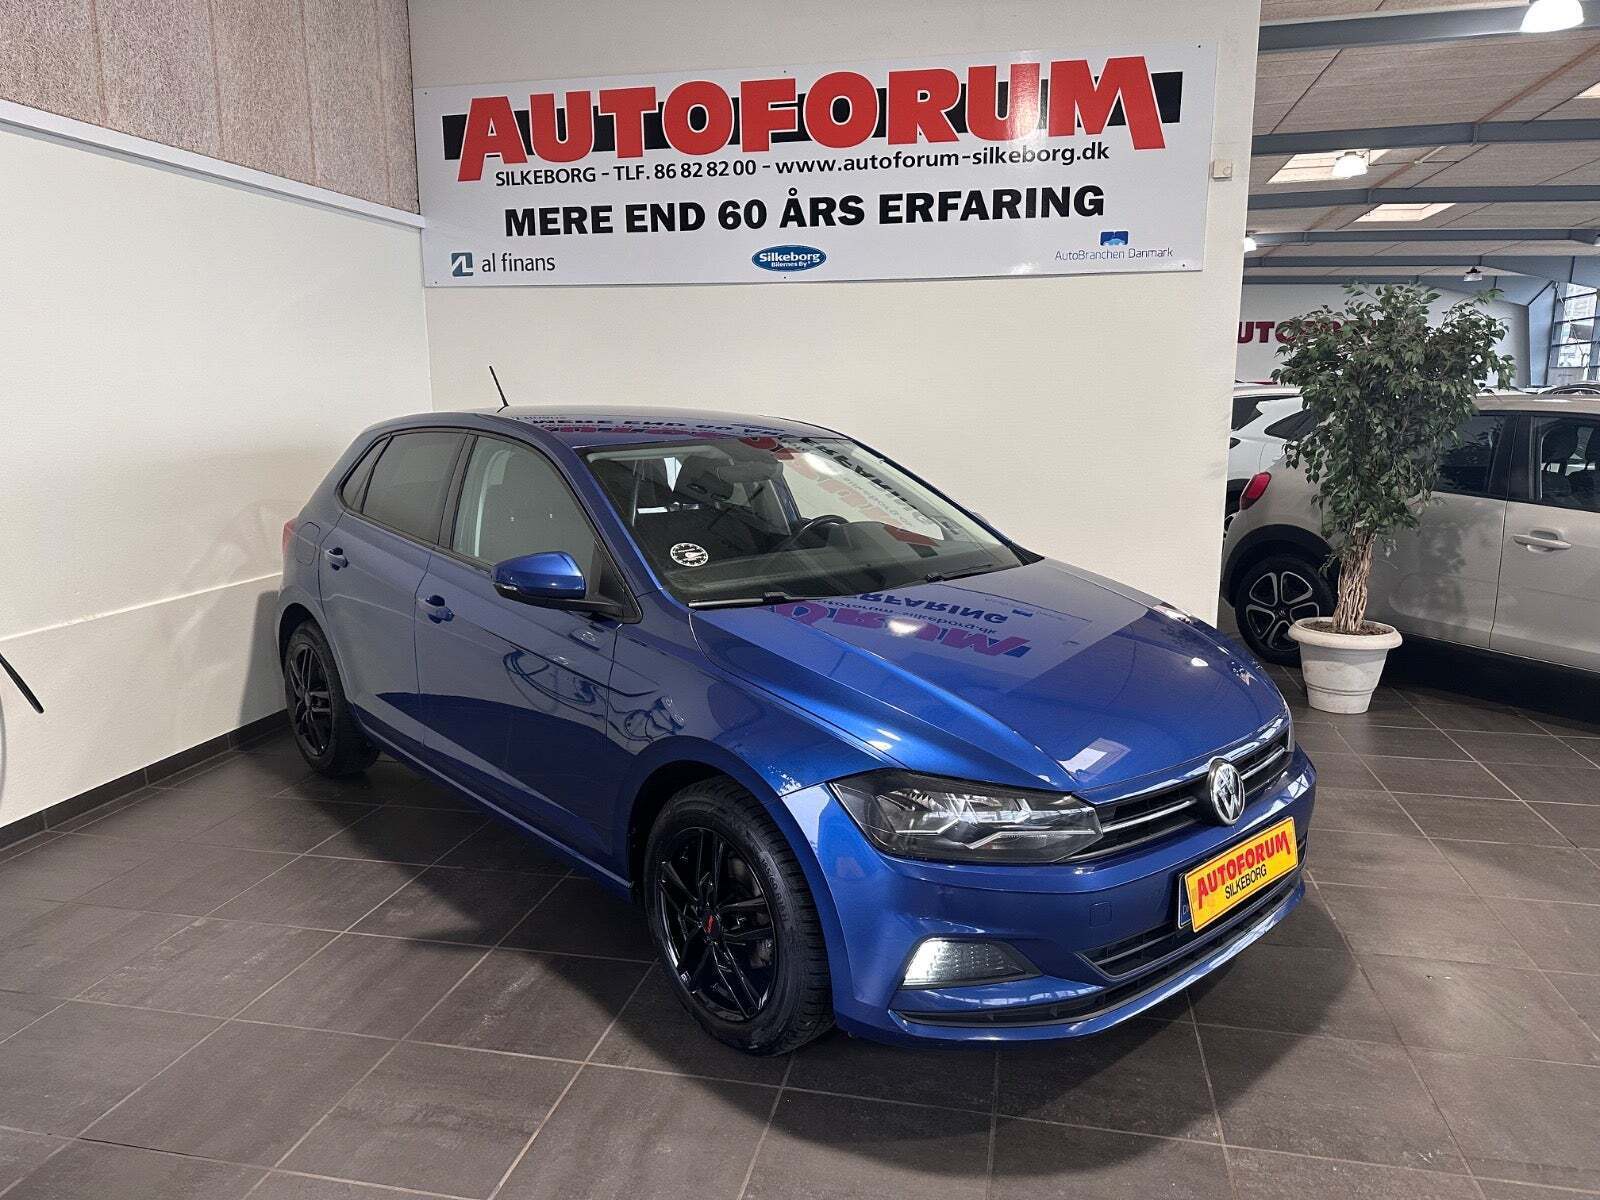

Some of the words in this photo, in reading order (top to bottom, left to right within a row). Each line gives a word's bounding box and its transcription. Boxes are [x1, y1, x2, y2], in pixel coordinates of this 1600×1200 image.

[457, 56, 1166, 182] AUTOFORUM
[496, 167, 596, 187] SILKEBORG
[613, 164, 651, 182] TLF.
[775, 142, 1110, 175] www.autoforum-silkeborg.dk
[505, 204, 614, 237] MERE
[625, 201, 706, 233] END
[717, 198, 767, 231] 60
[779, 187, 865, 228] ÅRS
[878, 184, 1105, 225] ERFARING
[482, 252, 496, 273] al
[501, 252, 556, 272] finans
[759, 252, 821, 263] Silkeborg
[1055, 248, 1125, 261] AutoBranchen
[1128, 247, 1174, 259] Danmark
[1196, 830, 1291, 910] AUTOFORUM
[1224, 863, 1267, 899] SILKEBORG
